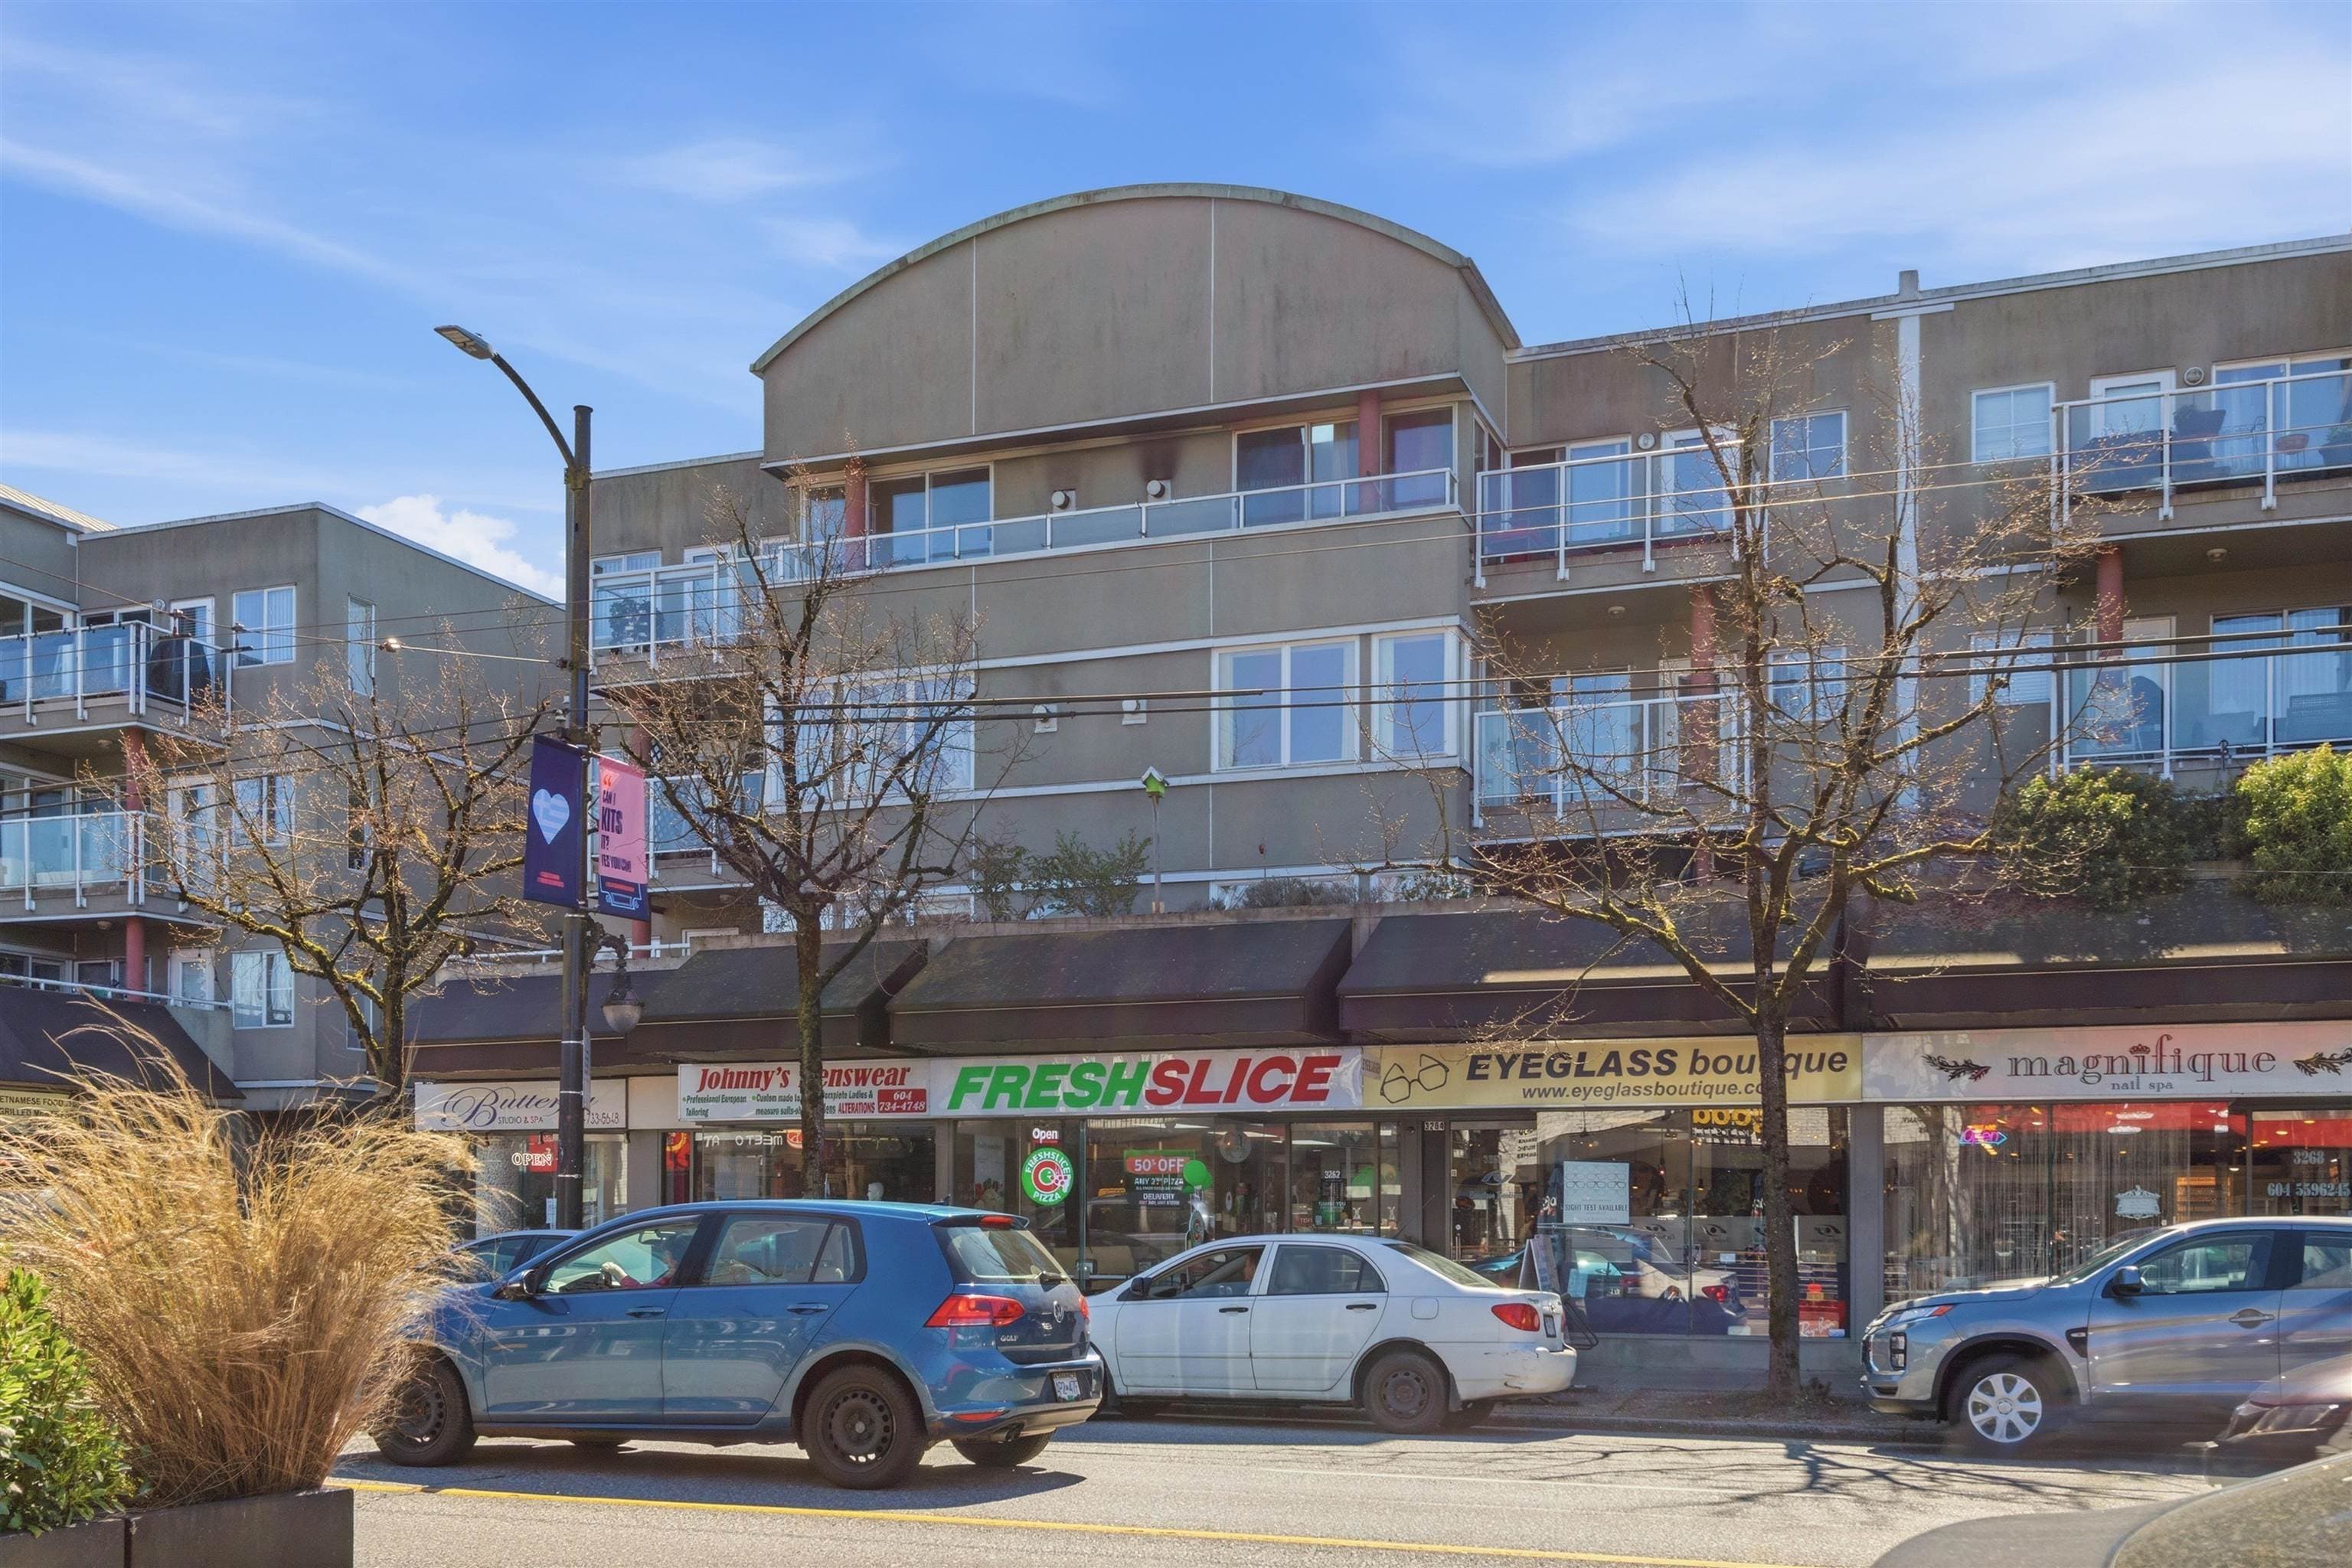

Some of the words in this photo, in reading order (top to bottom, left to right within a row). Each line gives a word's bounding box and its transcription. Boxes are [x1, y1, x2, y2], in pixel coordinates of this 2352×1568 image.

[603, 790, 612, 804] CAN
[601, 806, 622, 835] KITS
[601, 835, 609, 850] IT?
[1466, 1049, 1679, 1080] EYEGLASS
[1689, 1048, 1848, 1080] bouque
[2007, 1034, 2276, 1085] magnifique
[696, 1067, 790, 1093] Johnny's
[799, 1067, 911, 1088] enswear
[947, 1056, 1341, 1109] FRESHSLICE
[2111, 1076, 2141, 1090] nail
[2148, 1080, 2174, 1093] spa
[893, 1091, 913, 1100] 604
[1522, 1080, 1763, 1102] www.eyeglassboutique.co
[686, 1095, 720, 1103] Professional
[721, 1094, 747, 1104] European
[441, 1086, 599, 1128] Butter
[686, 1108, 709, 1118] Tailoring
[838, 1102, 875, 1114] ALTERATIONS
[498, 1116, 521, 1125] STUDIO
[524, 1116, 529, 1125] &
[530, 1116, 544, 1125] SPA
[1032, 1128, 1058, 1144] Open
[511, 1153, 552, 1166] OPEN
[1025, 1151, 1071, 1173] FRESHSLICE
[2293, 1151, 2325, 1164] 3268
[1158, 1158, 1184, 1172] OFF
[1033, 1191, 1061, 1202] PIZZA
[2267, 1183, 2291, 1197] 604
